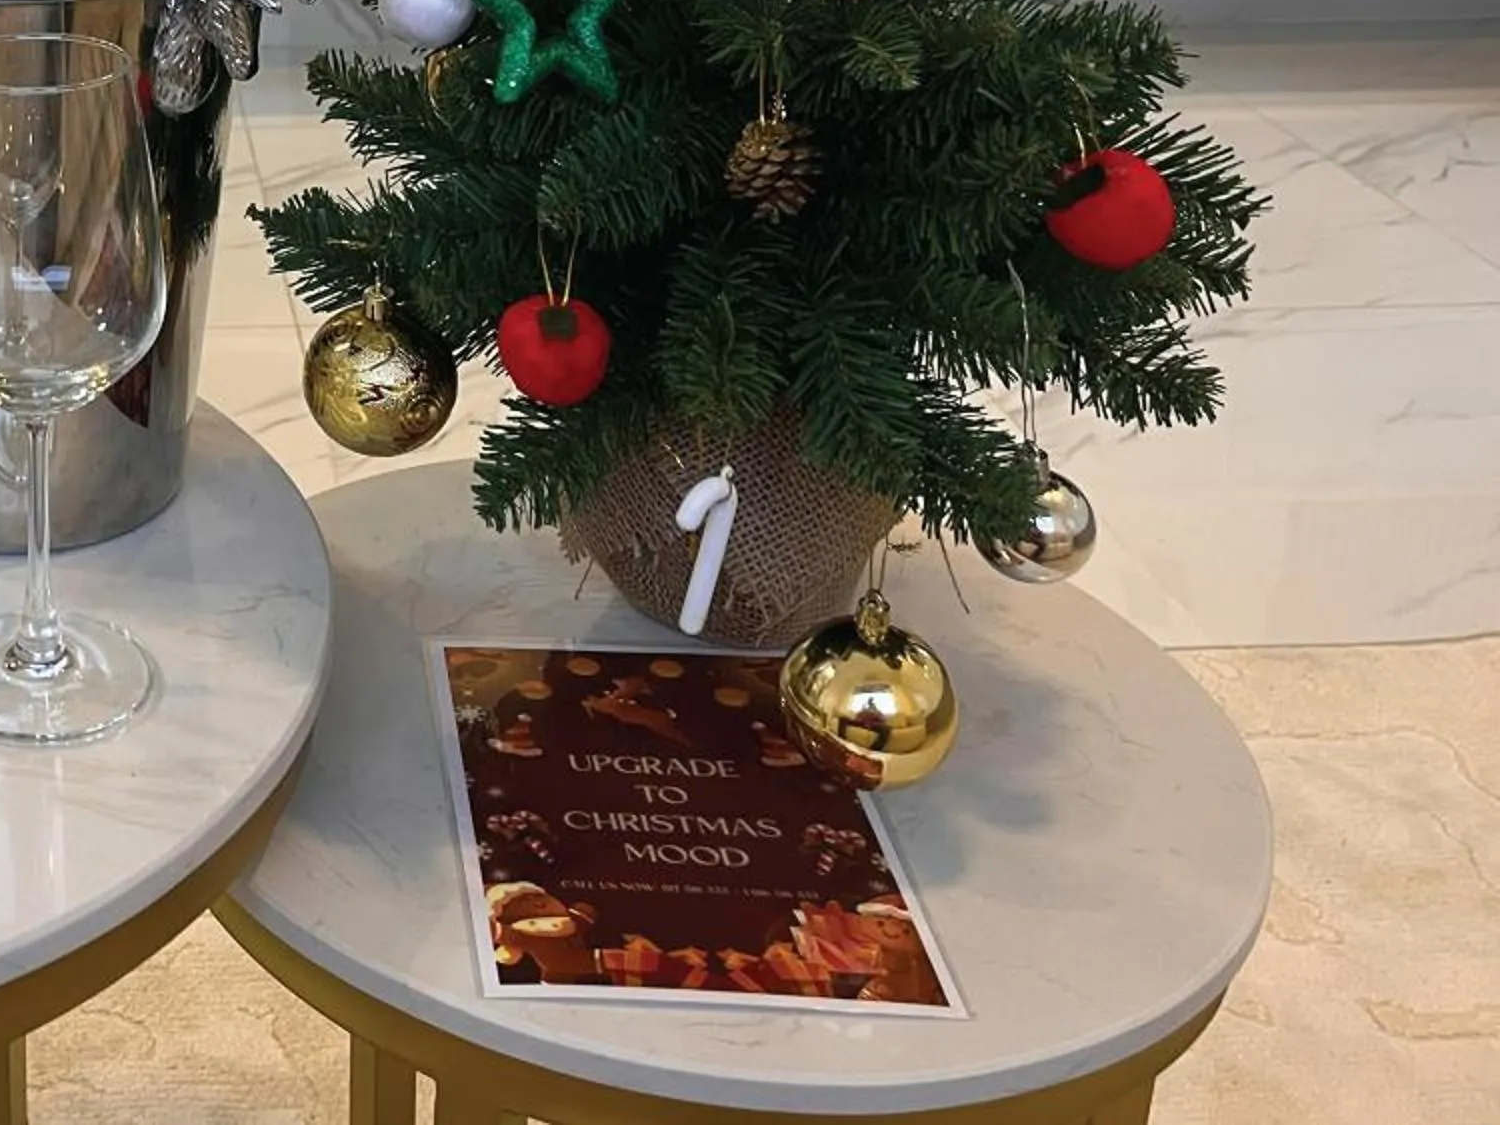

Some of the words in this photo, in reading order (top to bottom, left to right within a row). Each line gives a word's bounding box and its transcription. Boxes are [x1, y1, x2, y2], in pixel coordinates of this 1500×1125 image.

[568, 753, 740, 778] UPGRADE
[633, 784, 689, 804] TO
[563, 810, 782, 838] CHRISTMAS
[624, 842, 750, 867] MOOD
